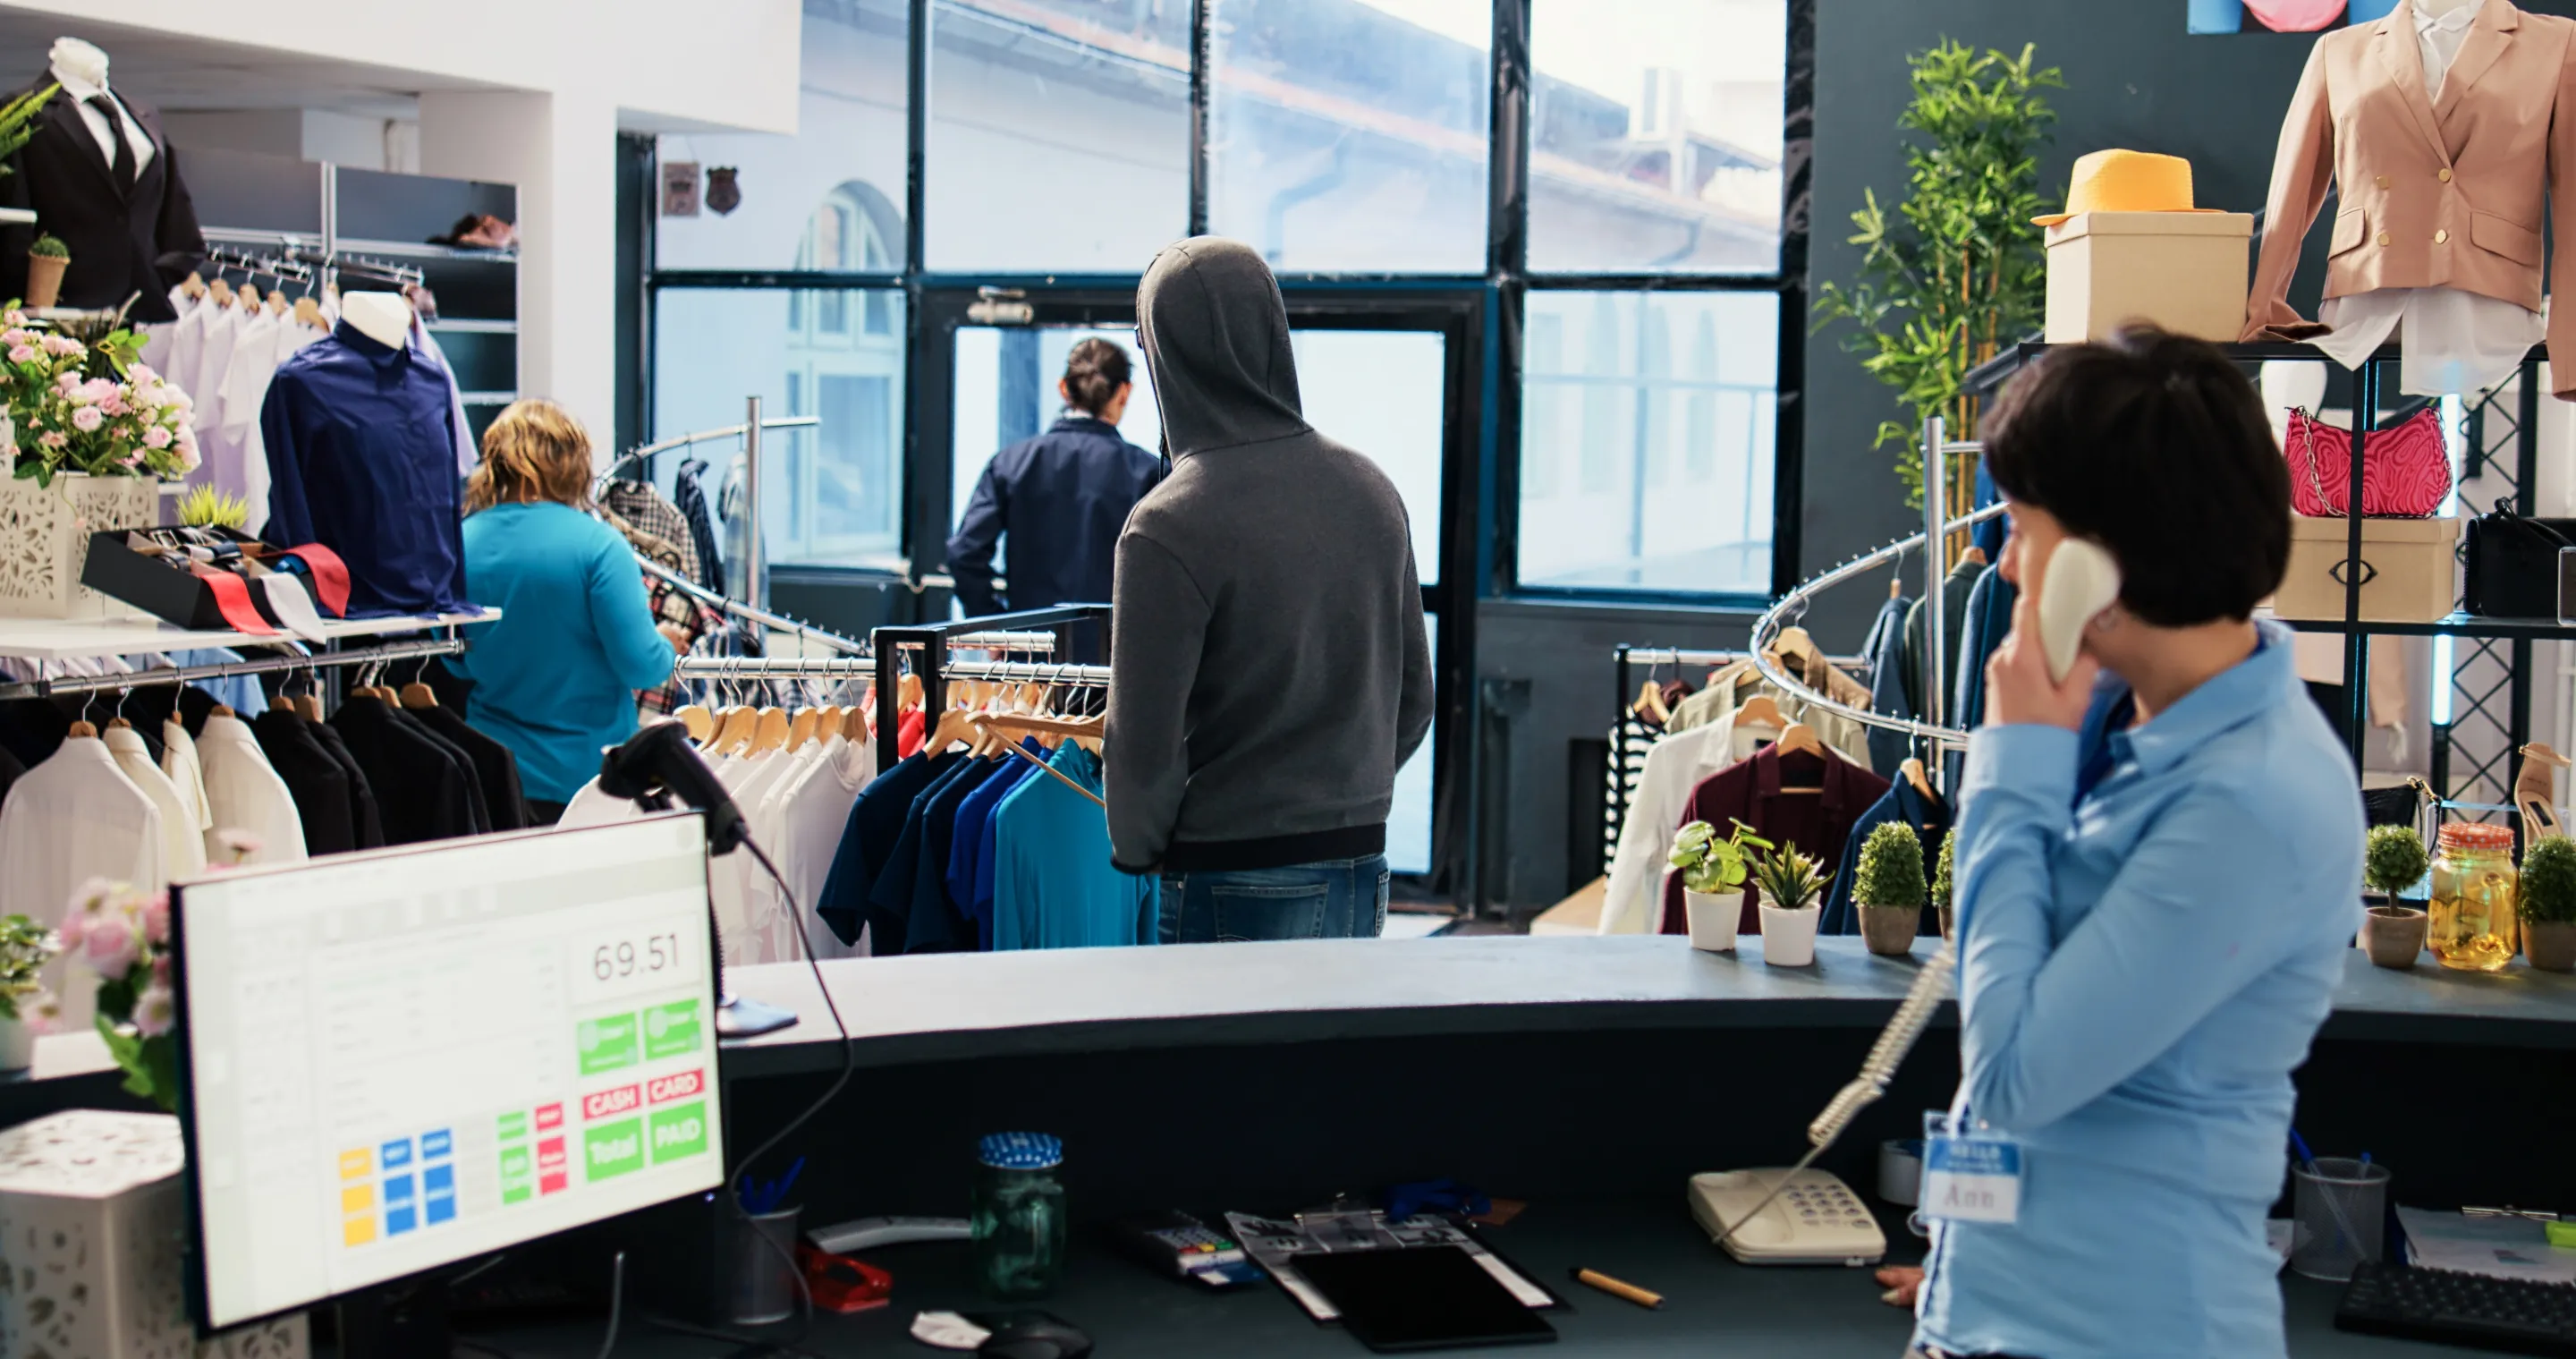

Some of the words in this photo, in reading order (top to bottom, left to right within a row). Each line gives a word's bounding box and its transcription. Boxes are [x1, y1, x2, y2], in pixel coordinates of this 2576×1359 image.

[594, 932, 678, 981] 69.51
[588, 1087, 637, 1117] CASH
[651, 1074, 699, 1100] CARD
[589, 1132, 638, 1165] Total
[655, 1117, 701, 1150] PAID
[1945, 1182, 1996, 1210] Ann
